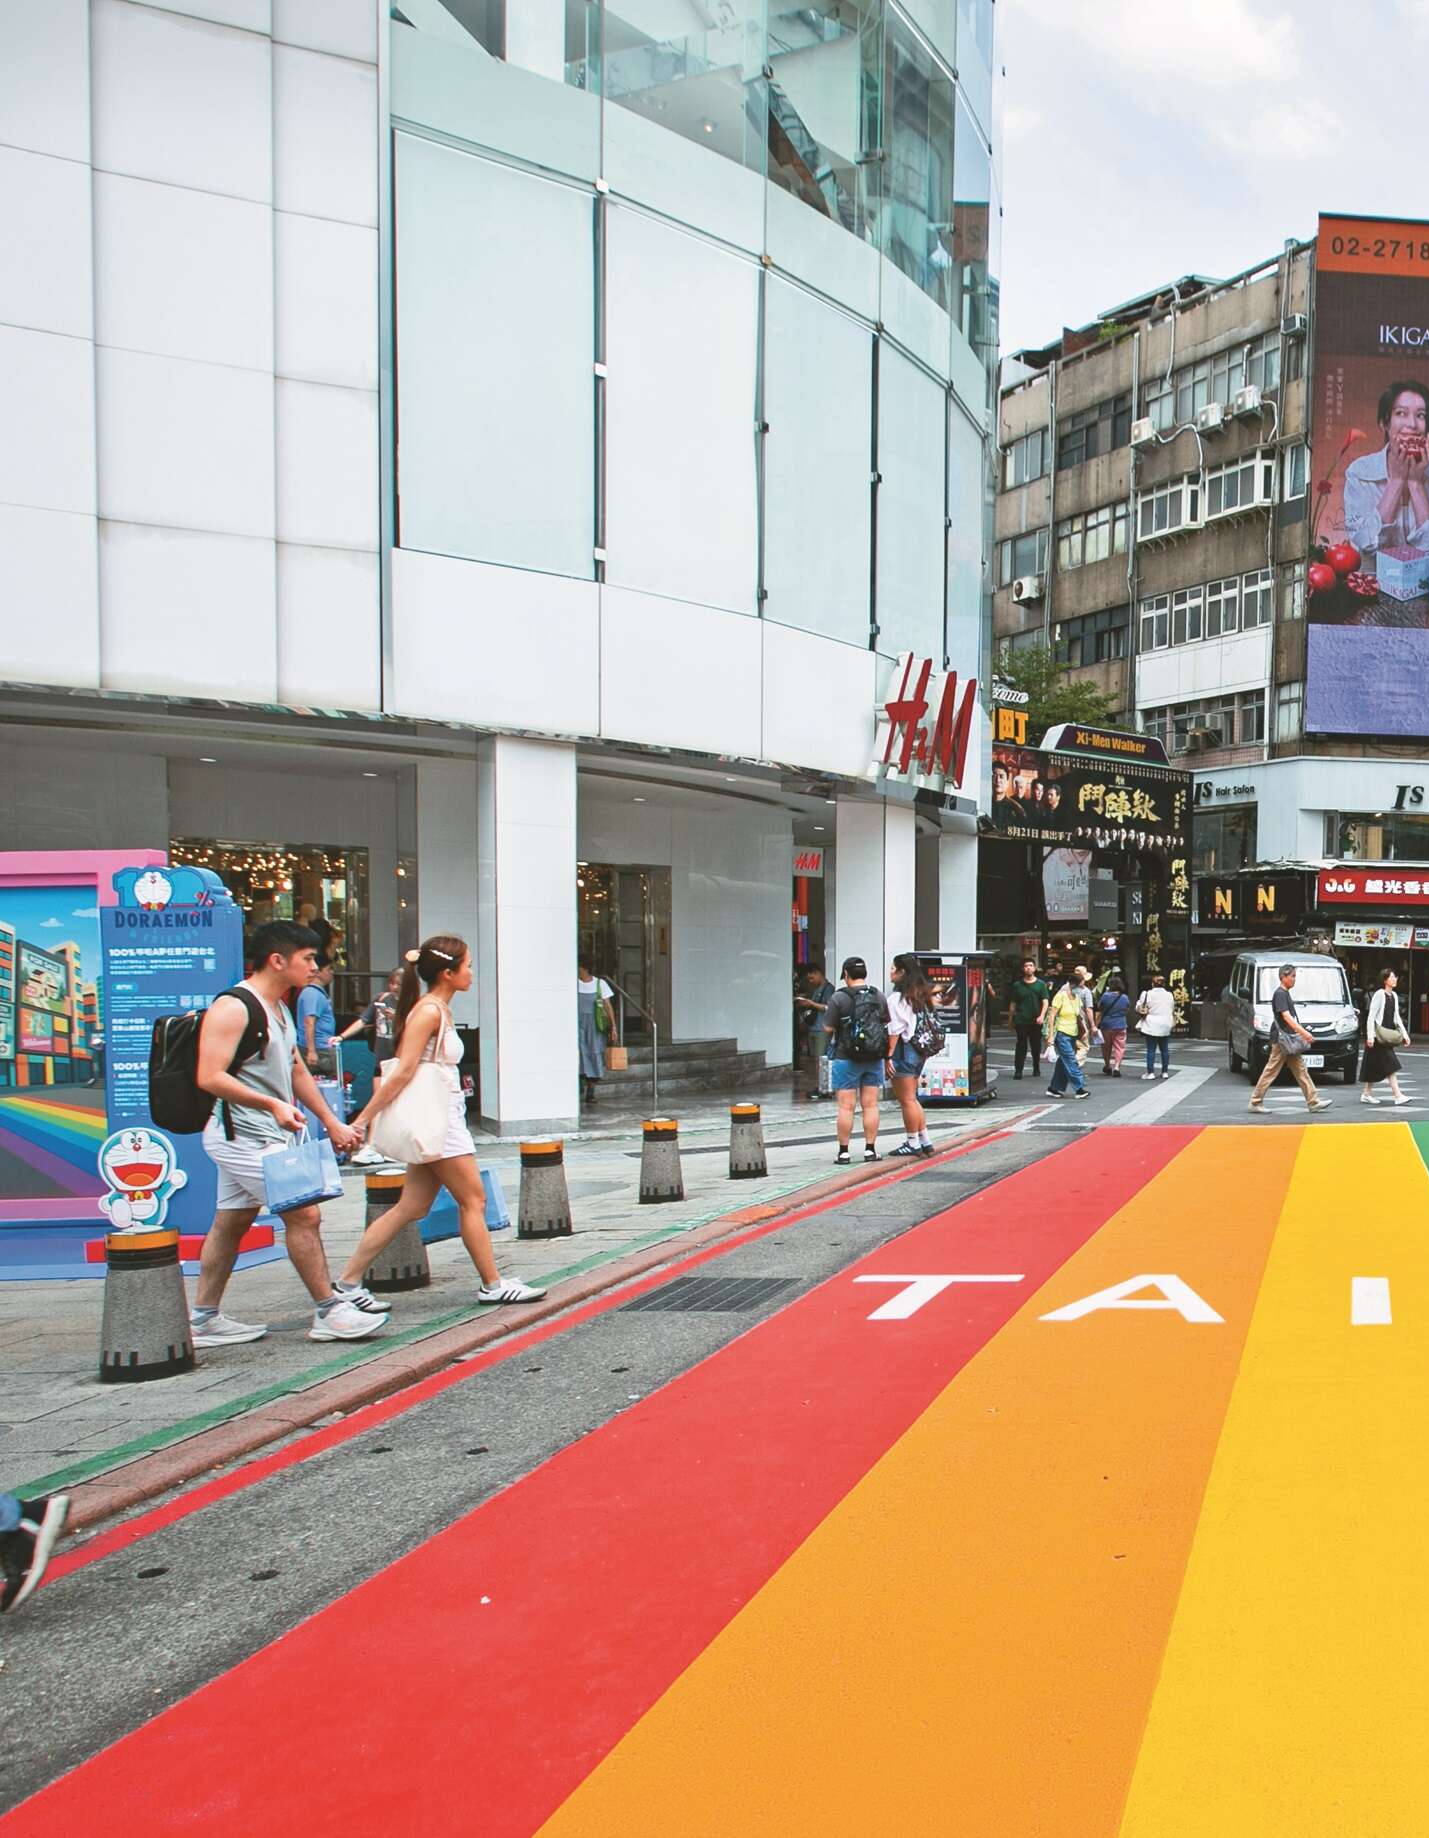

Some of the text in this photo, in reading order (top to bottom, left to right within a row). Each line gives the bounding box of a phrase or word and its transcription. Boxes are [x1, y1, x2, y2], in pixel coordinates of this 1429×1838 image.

[884, 651, 977, 789] H&M
[1076, 731, 1147, 754] Xi-Men Walker
[1216, 786, 1231, 797] Hair
[1233, 784, 1255, 796] Salon
[1391, 785, 1424, 810] IS
[1007, 825, 1039, 839] 8月21日
[114, 909, 213, 929] DORAEMON
